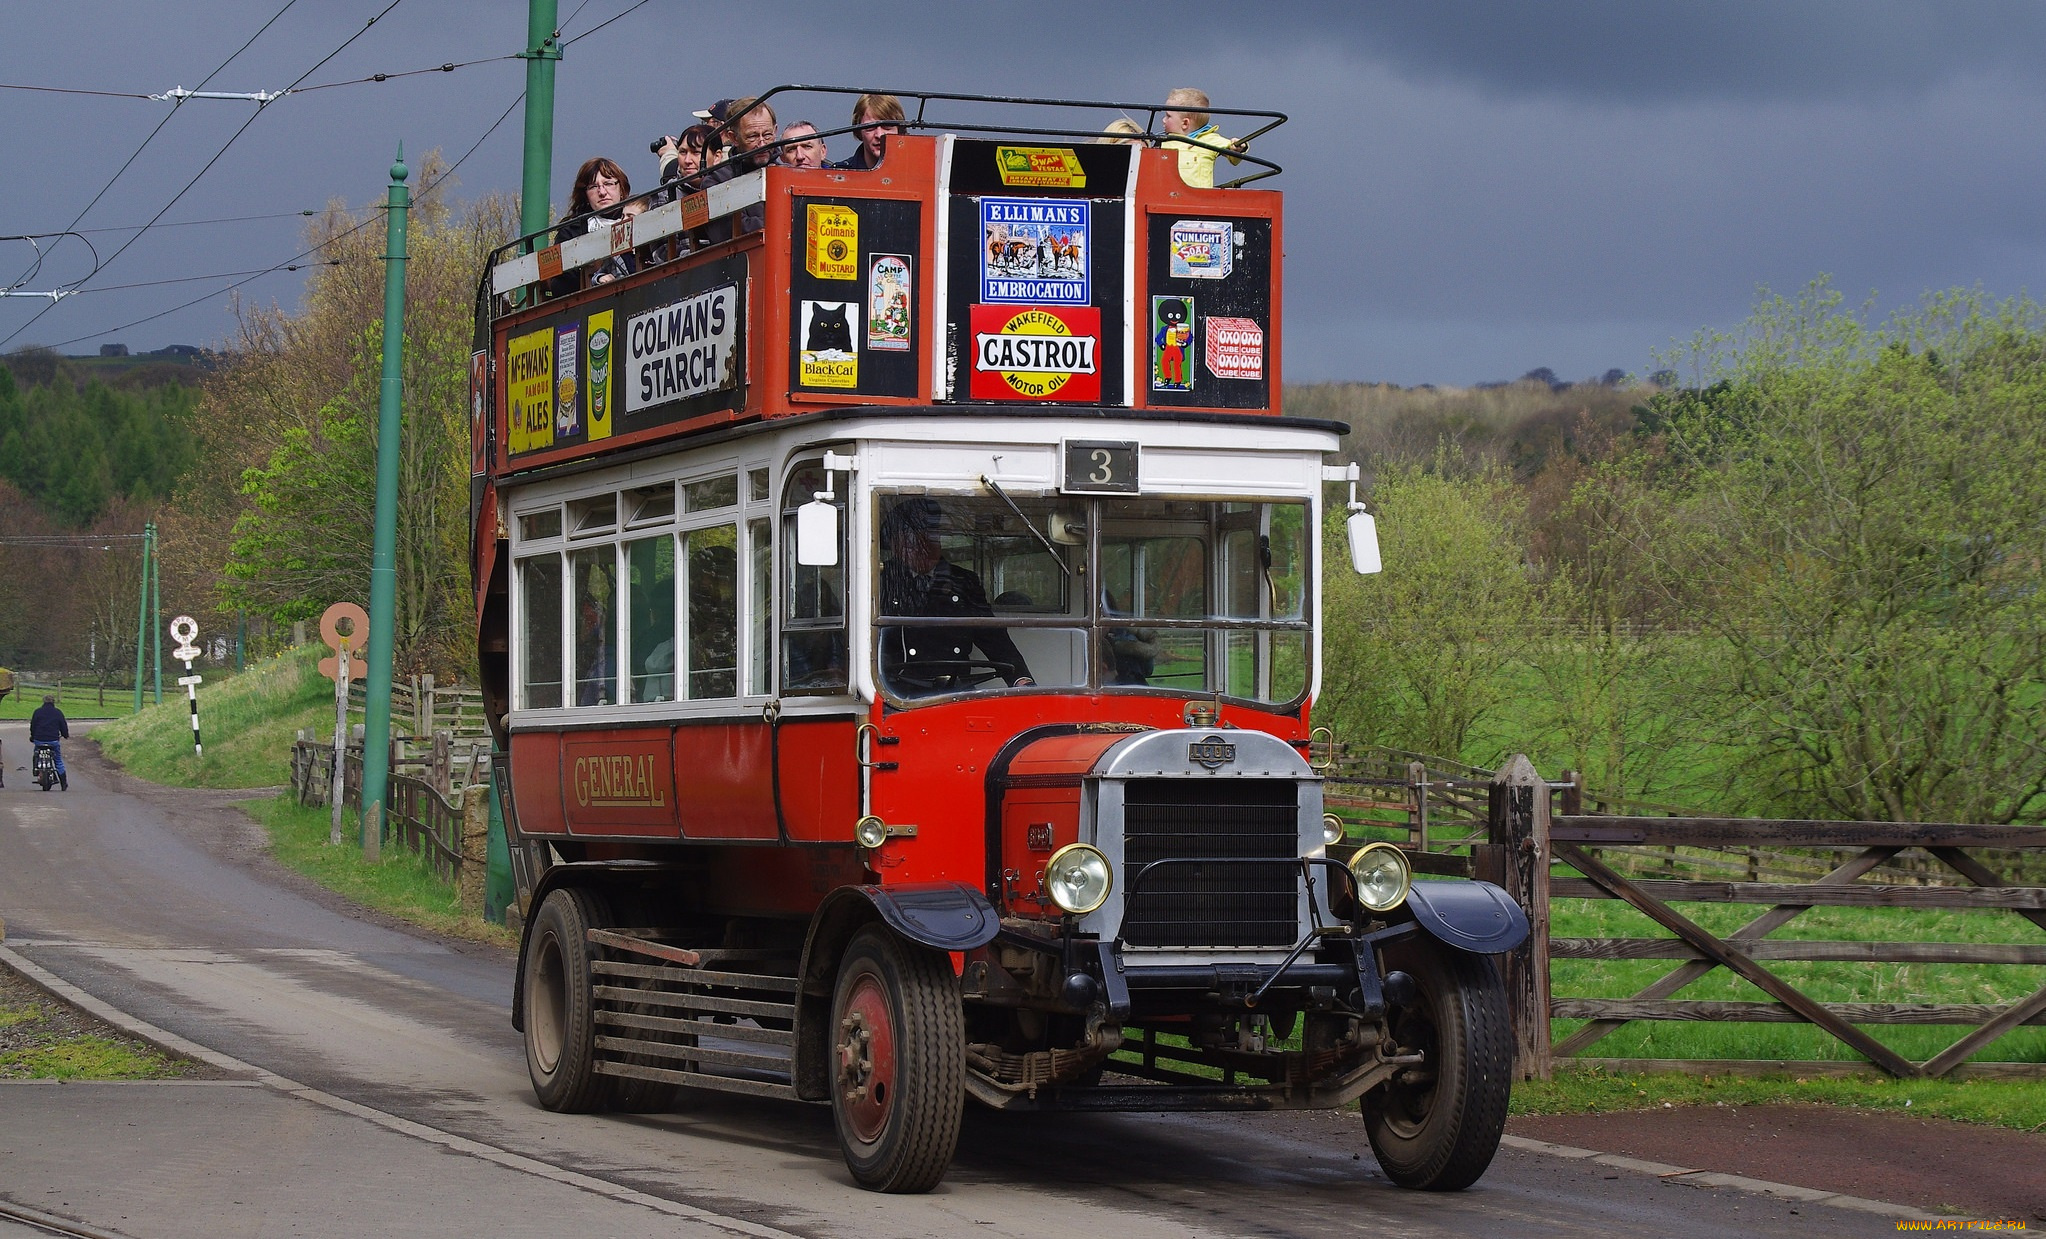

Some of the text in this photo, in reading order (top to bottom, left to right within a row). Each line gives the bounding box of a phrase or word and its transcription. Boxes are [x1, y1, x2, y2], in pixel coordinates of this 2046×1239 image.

[1030, 154, 1060, 166] SWAN
[990, 204, 1080, 223] ELLIMAN'S
[820, 225, 855, 238] Colman's
[1174, 232, 1221, 247] SUNLIGHT
[1180, 245, 1209, 258] SOAP
[820, 261, 855, 274] MUSTARD
[988, 281, 1082, 300] EMBROCATION
[631, 294, 726, 360] COLMAN'S
[1006, 313, 1066, 334] WAKEFIELD
[1220, 330, 1240, 344] OXO
[1241, 331, 1261, 345] OXO
[983, 338, 1094, 369] CASTROL
[1219, 345, 1239, 353] CUBE
[1241, 346, 1261, 354] CUBE
[1219, 354, 1239, 368] OXO
[1240, 355, 1261, 369] OXO
[640, 344, 717, 402] STARCH
[805, 363, 853, 376] Black Cat
[525, 380, 549, 398] FAMOUS
[1006, 373, 1067, 396] MOTOR OIL
[525, 400, 549, 434] ALES
[1089, 448, 1112, 484] 3
[173, 617, 195, 627] SPEED
[173, 630, 197, 642] LIMIT
[574, 754, 665, 807] GENERAL
